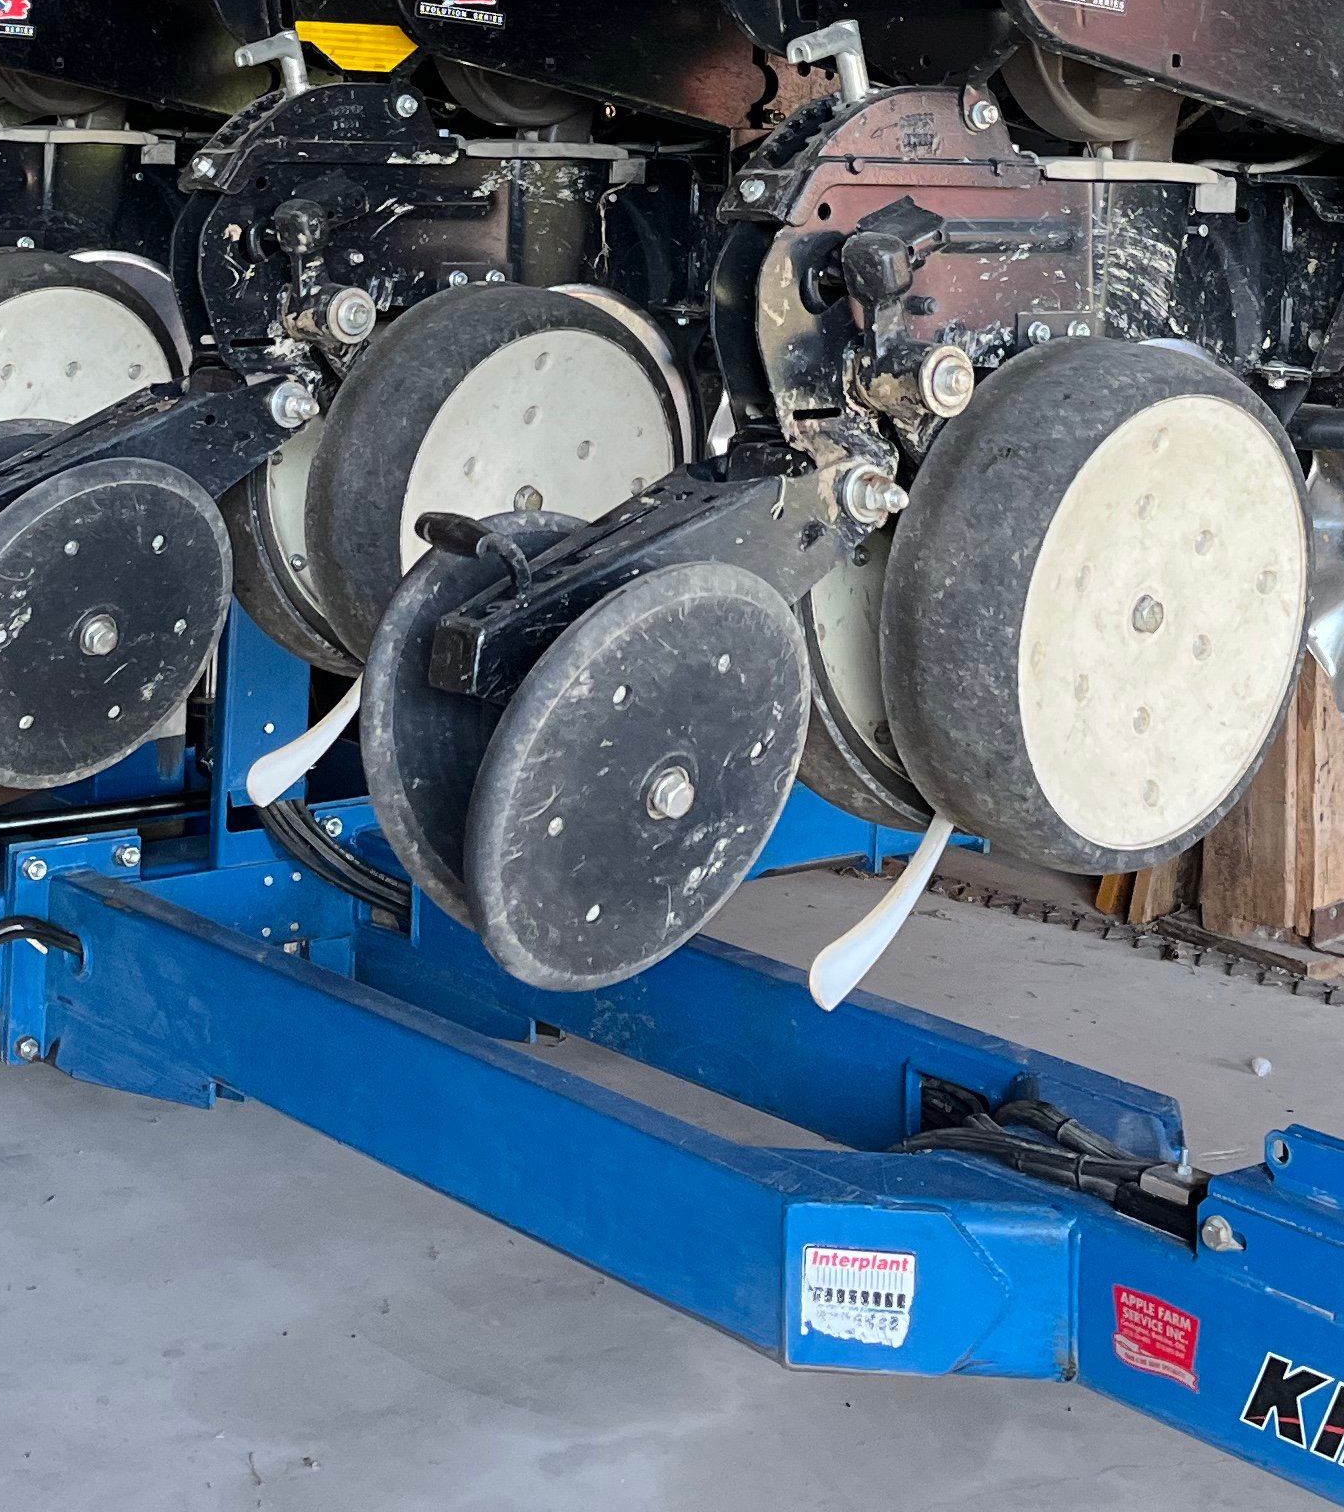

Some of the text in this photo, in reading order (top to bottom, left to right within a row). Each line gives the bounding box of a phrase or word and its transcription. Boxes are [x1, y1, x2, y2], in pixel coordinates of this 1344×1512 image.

[812, 1251, 910, 1272] Interplant
[1120, 1291, 1192, 1332] APPLE FARM
[1122, 1306, 1163, 1333] SERVICE
[1166, 1325, 1189, 1345] INC.
